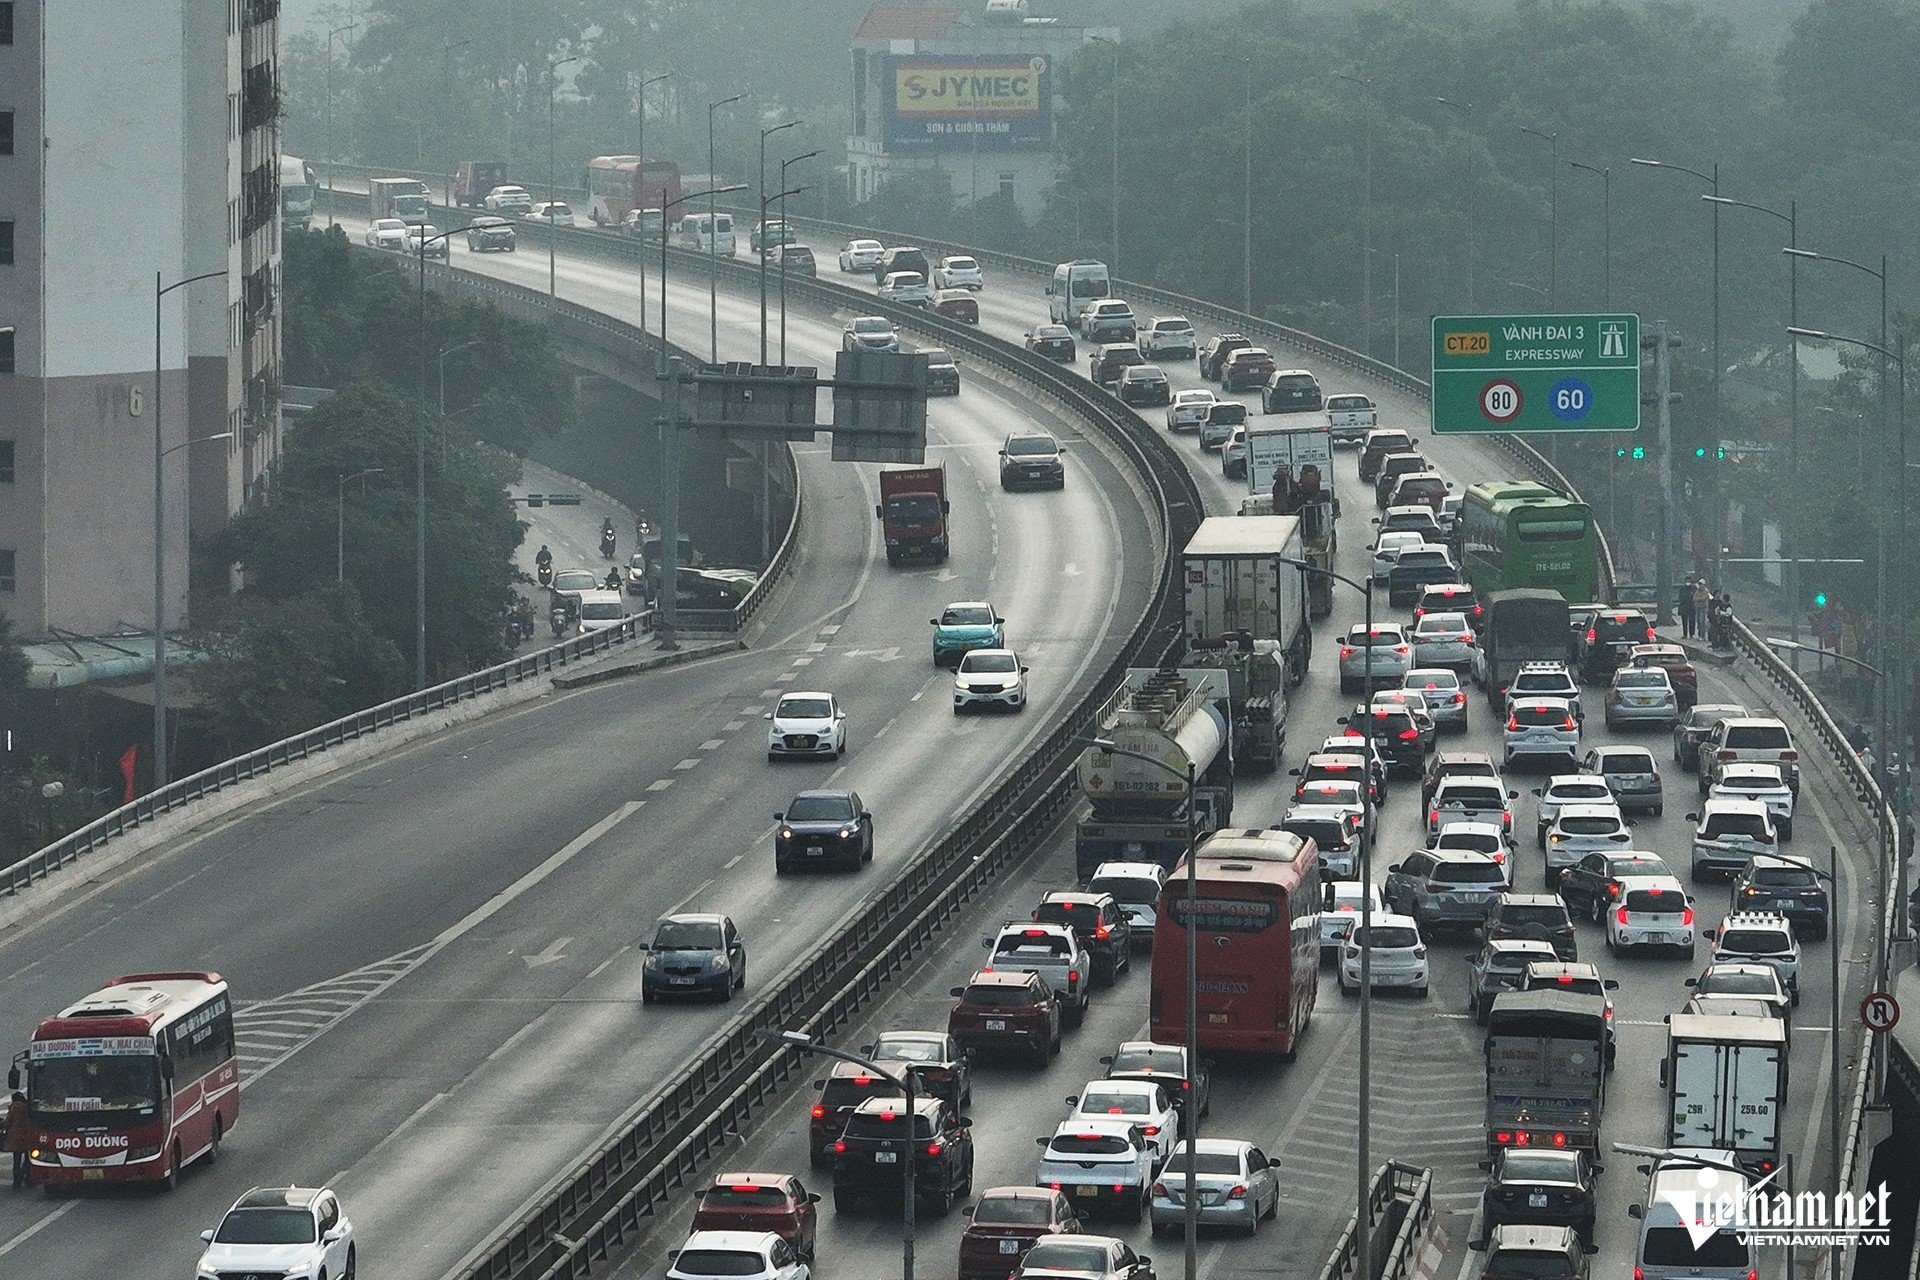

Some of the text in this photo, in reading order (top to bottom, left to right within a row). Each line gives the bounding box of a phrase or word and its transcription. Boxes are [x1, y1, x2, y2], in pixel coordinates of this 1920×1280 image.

[1502, 323, 1584, 340] VÀNH ĐAI 3
[1447, 336, 1487, 350] CT.20
[1505, 349, 1585, 360] EXPRESSWAY
[1491, 391, 1511, 410] 80
[1557, 389, 1584, 410] 60
